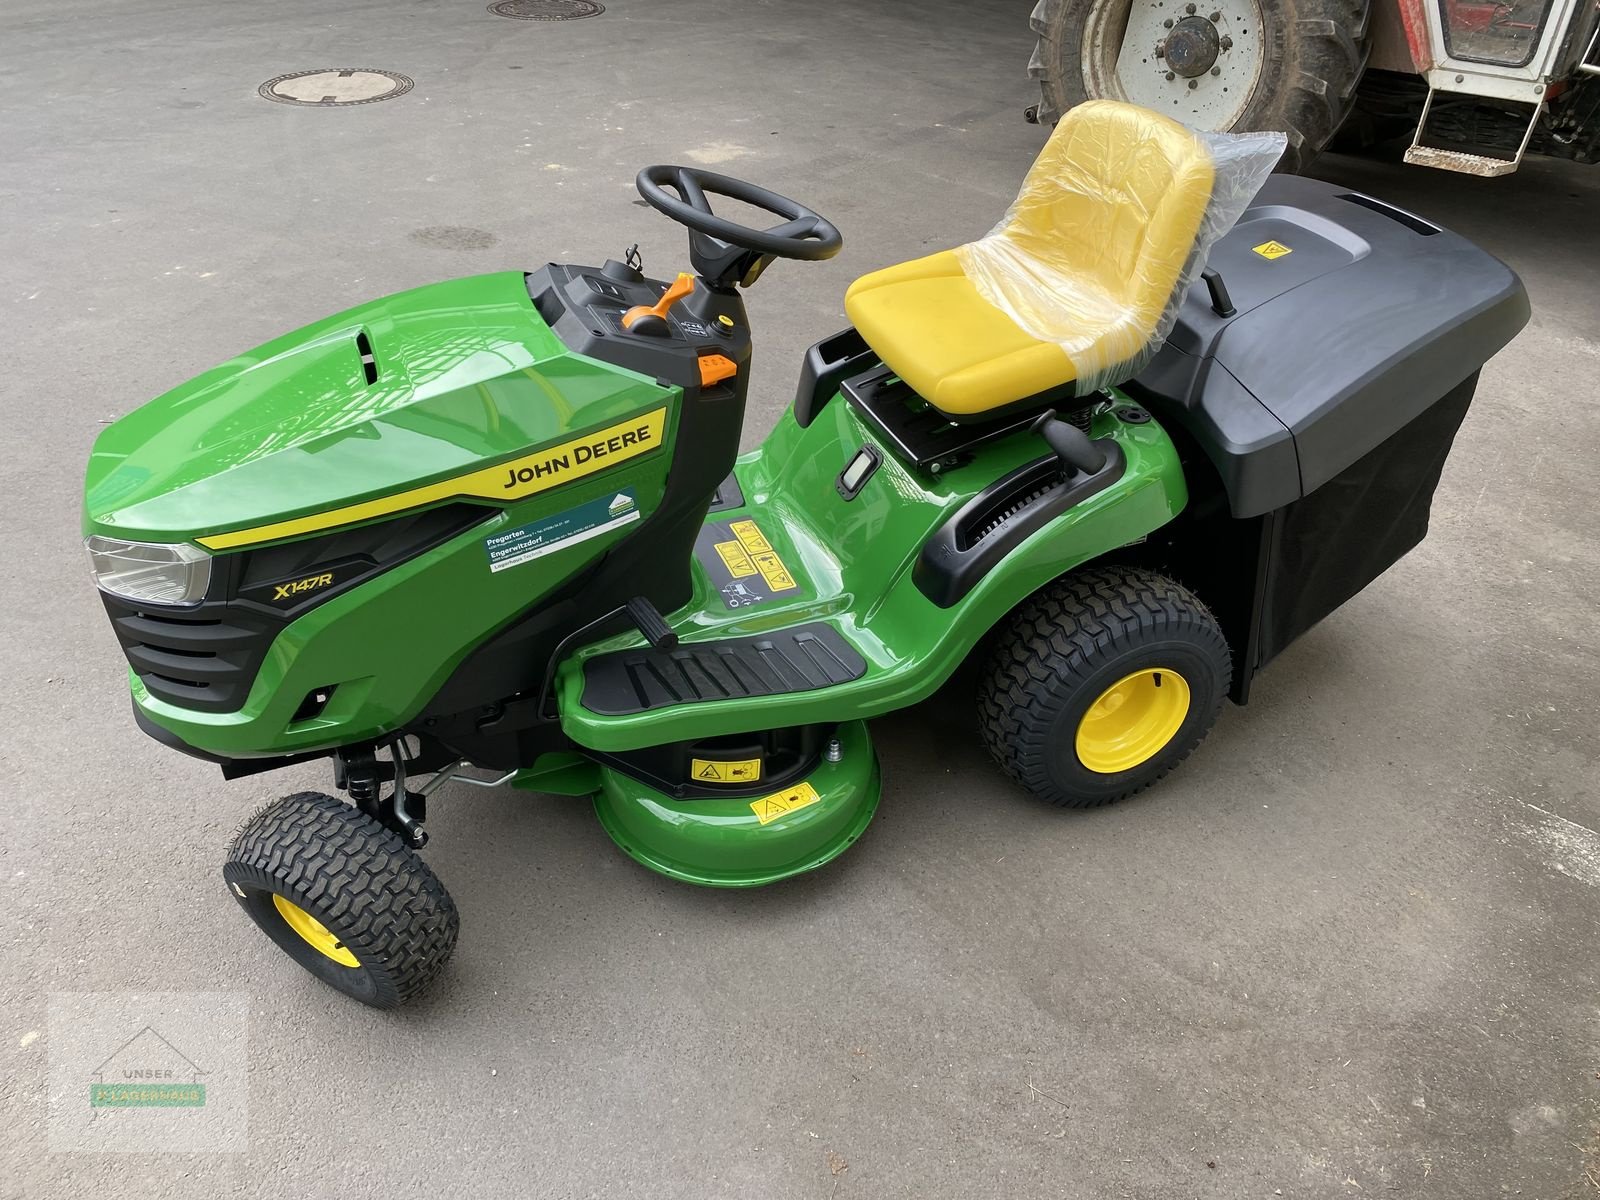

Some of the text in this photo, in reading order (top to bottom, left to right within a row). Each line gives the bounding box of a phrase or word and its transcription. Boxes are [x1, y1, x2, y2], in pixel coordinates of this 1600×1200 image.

[504, 424, 651, 489] JOHN DEERE
[486, 530, 525, 546] Pregarten
[490, 535, 543, 559] Engerwitzdorf
[272, 573, 333, 601] X147R
